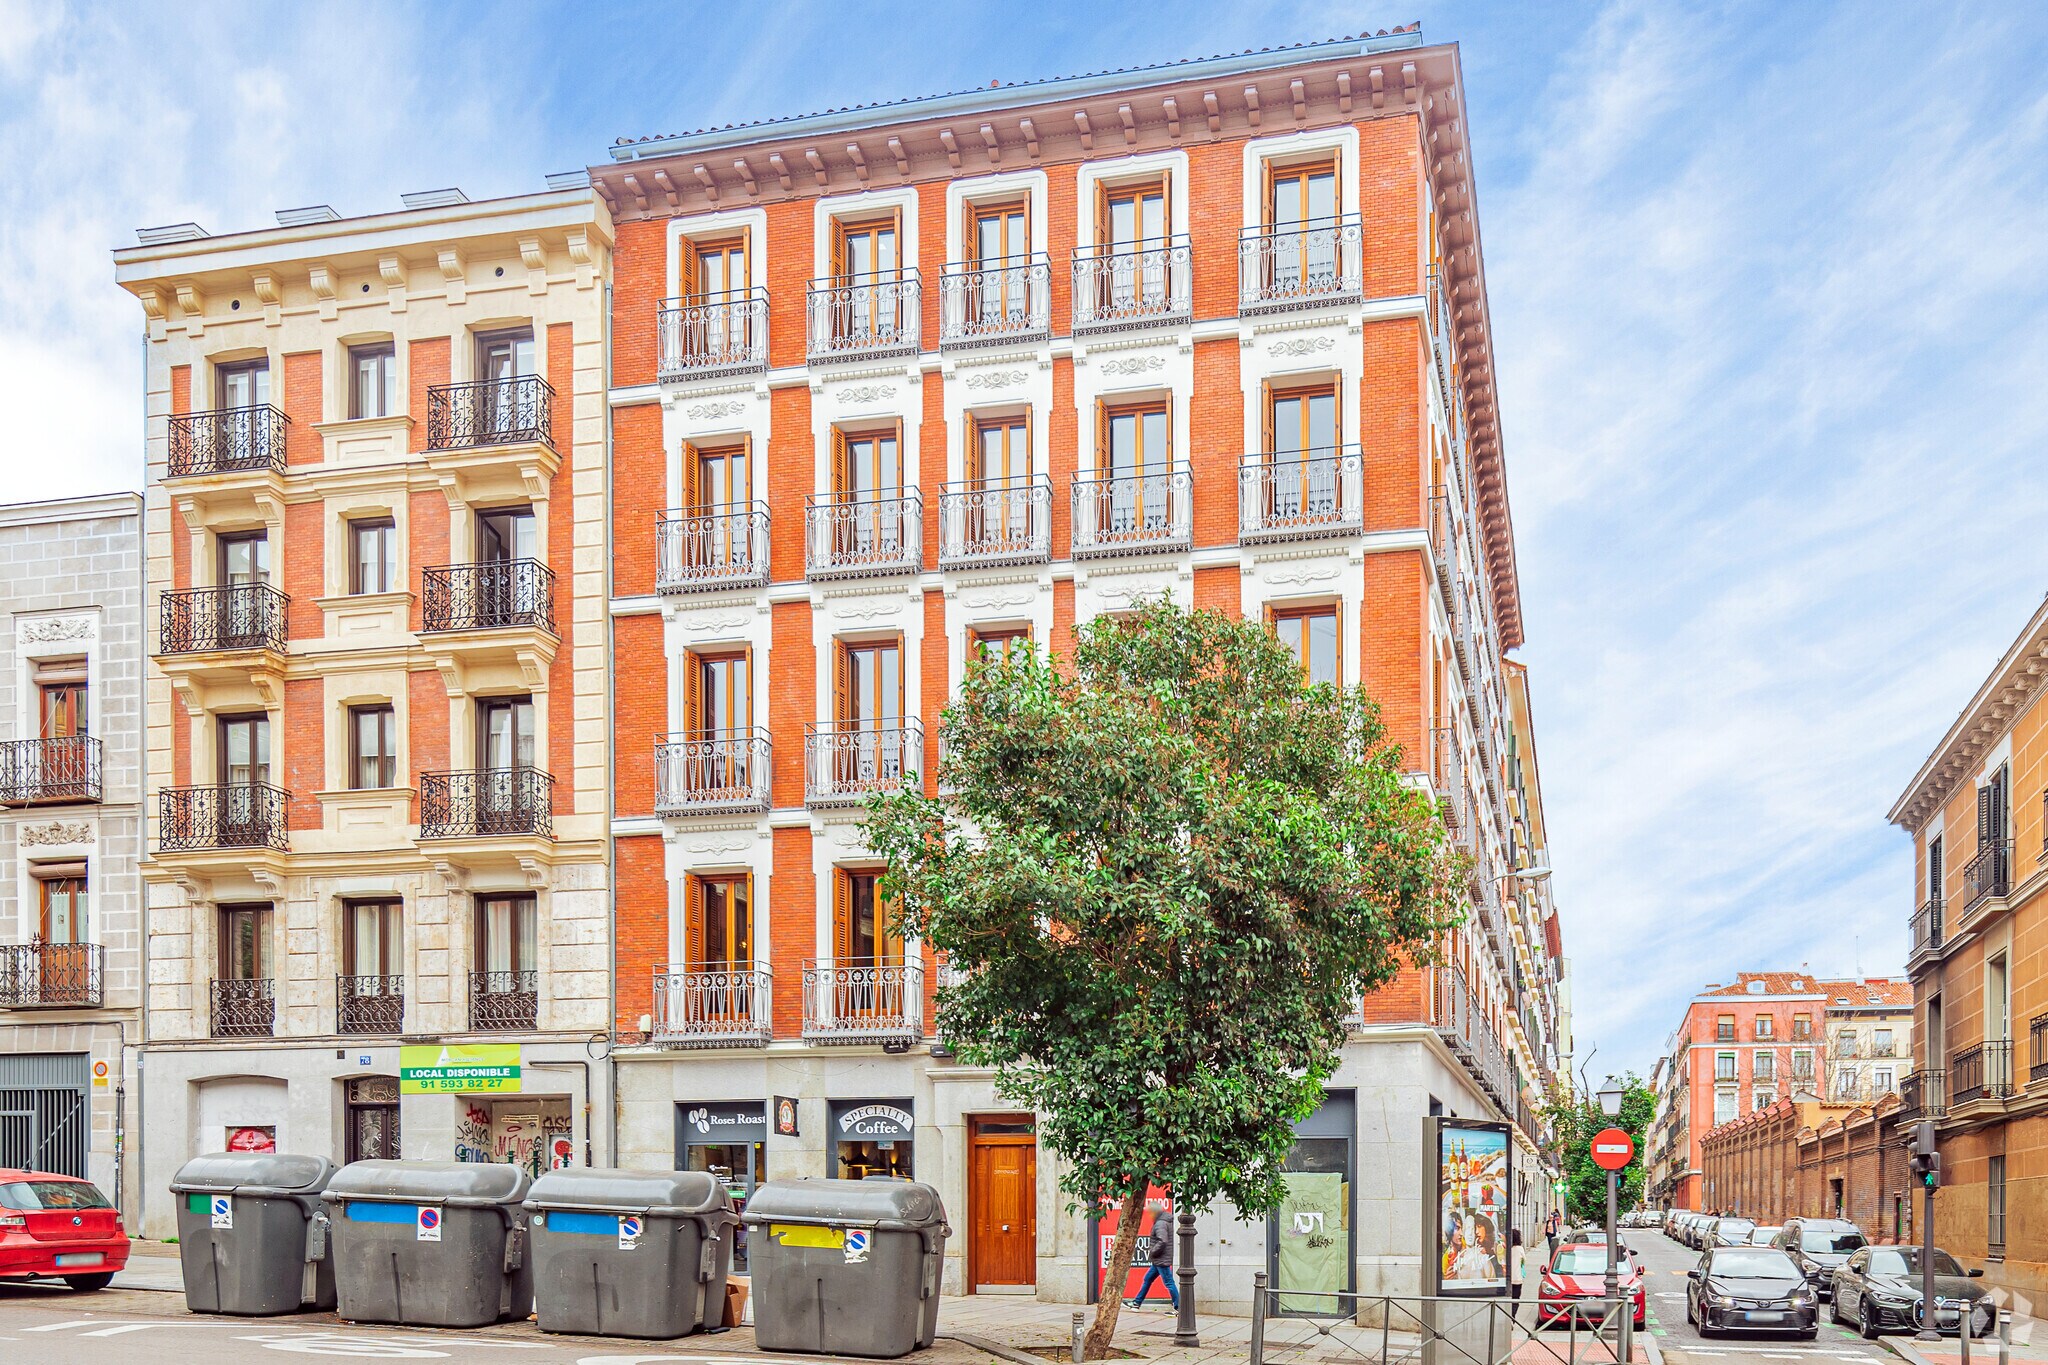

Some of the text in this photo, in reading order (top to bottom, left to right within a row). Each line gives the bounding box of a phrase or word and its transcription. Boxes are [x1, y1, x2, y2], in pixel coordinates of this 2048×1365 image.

[361, 1056, 370, 1065] 78
[409, 1067, 511, 1079] LOCAL DISPONIBLE
[420, 1078, 503, 1089] 91 593 82 27
[710, 1115, 736, 1125] Roses
[844, 1105, 910, 1126] SPECIALTY
[855, 1121, 898, 1134] Coffee
